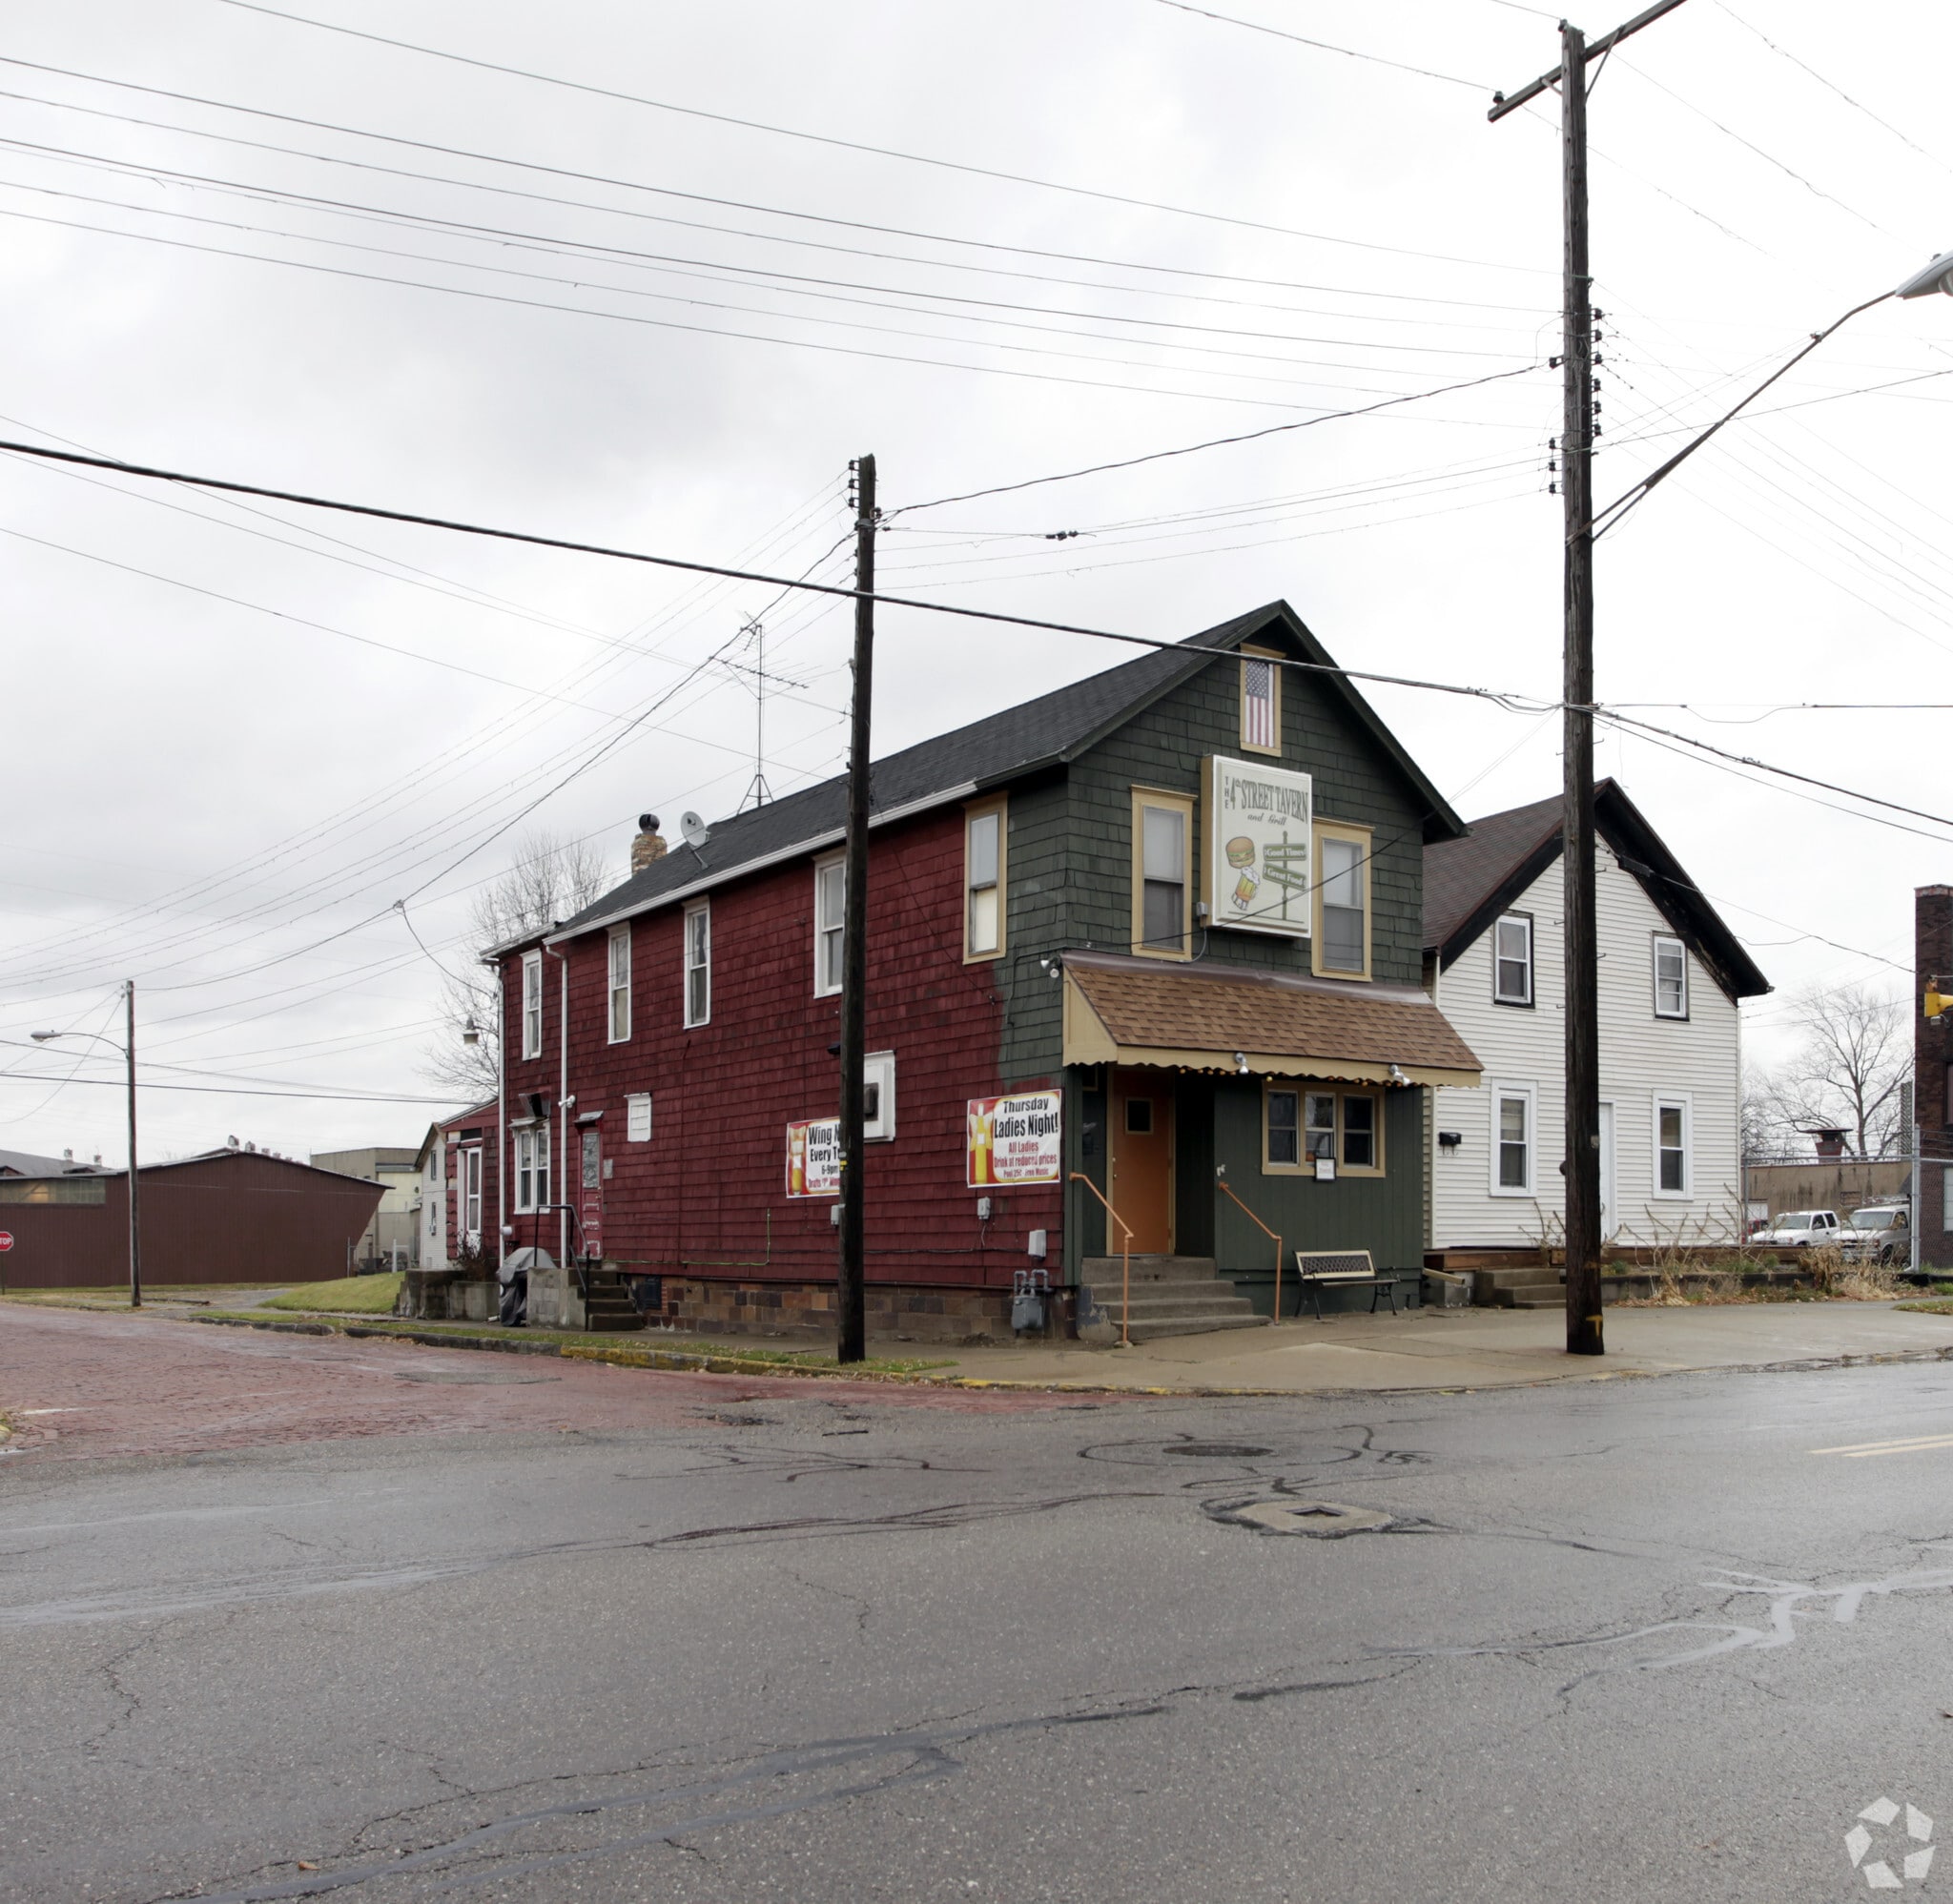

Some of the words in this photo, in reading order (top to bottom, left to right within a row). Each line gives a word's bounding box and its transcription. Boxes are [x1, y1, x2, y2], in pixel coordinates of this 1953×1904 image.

[1242, 779, 1274, 810] STREET
[1275, 786, 1308, 824] TAVERN
[1247, 812, 1264, 822] and
[1268, 814, 1286, 826] Grill
[1003, 1097, 1049, 1114] Thursday
[995, 1116, 1025, 1138] Ladies
[1028, 1113, 1058, 1136] Night!
[809, 1126, 833, 1145] Wing
[1018, 1141, 1038, 1153] Ladies
[811, 1148, 832, 1162] Every
[1015, 1154, 1038, 1167] reduced
[1038, 1153, 1057, 1165] prices
[822, 1164, 838, 1175] 6-9pm
